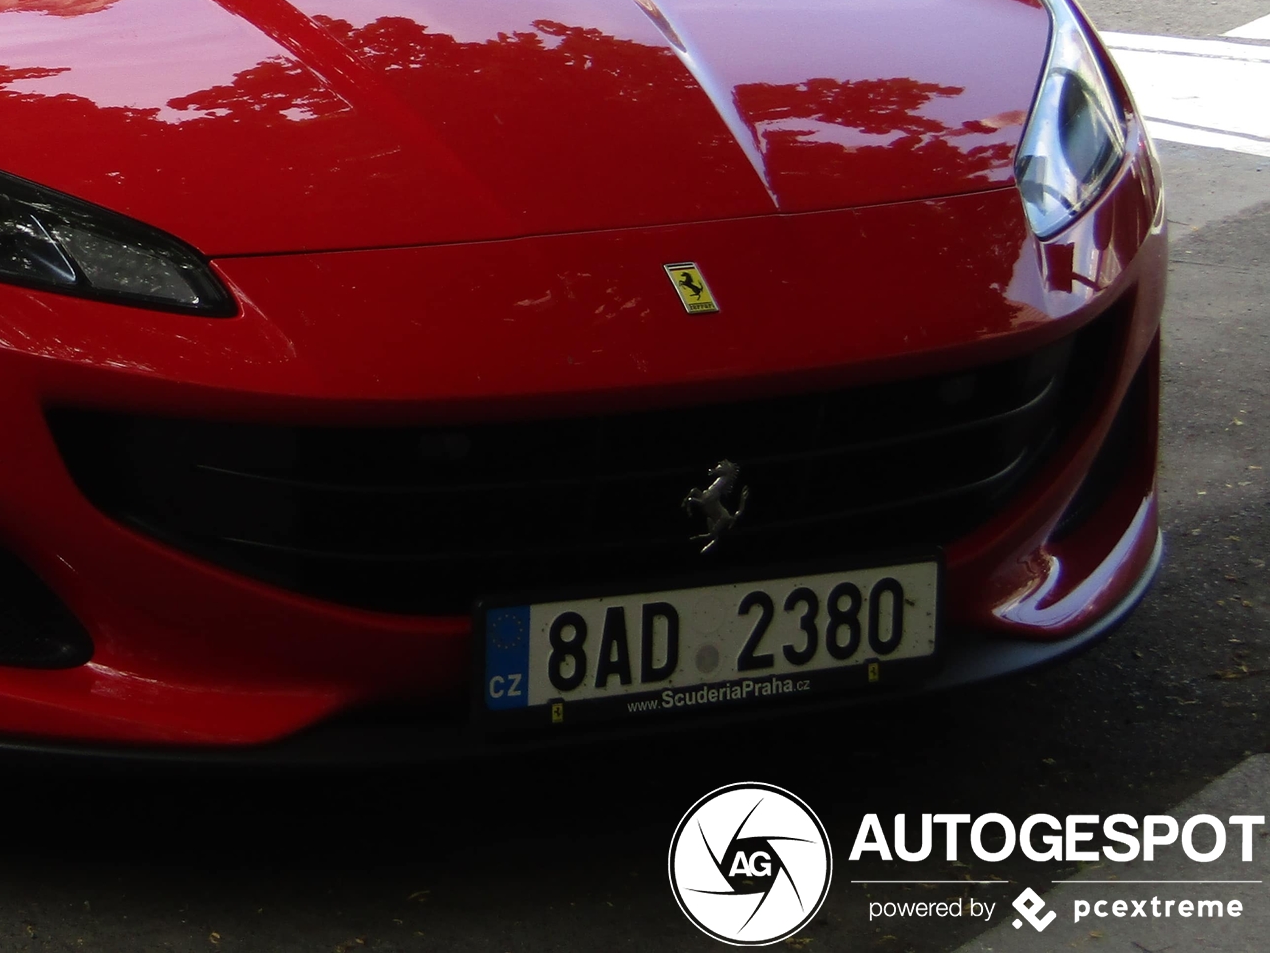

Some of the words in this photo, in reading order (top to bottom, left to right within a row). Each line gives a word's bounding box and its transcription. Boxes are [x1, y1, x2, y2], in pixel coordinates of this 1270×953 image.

[488, 673, 522, 700] CZ
[547, 601, 681, 692] 8AD
[736, 576, 905, 673] 2380
[627, 678, 811, 713] www.ScuderiaPraha.cz
